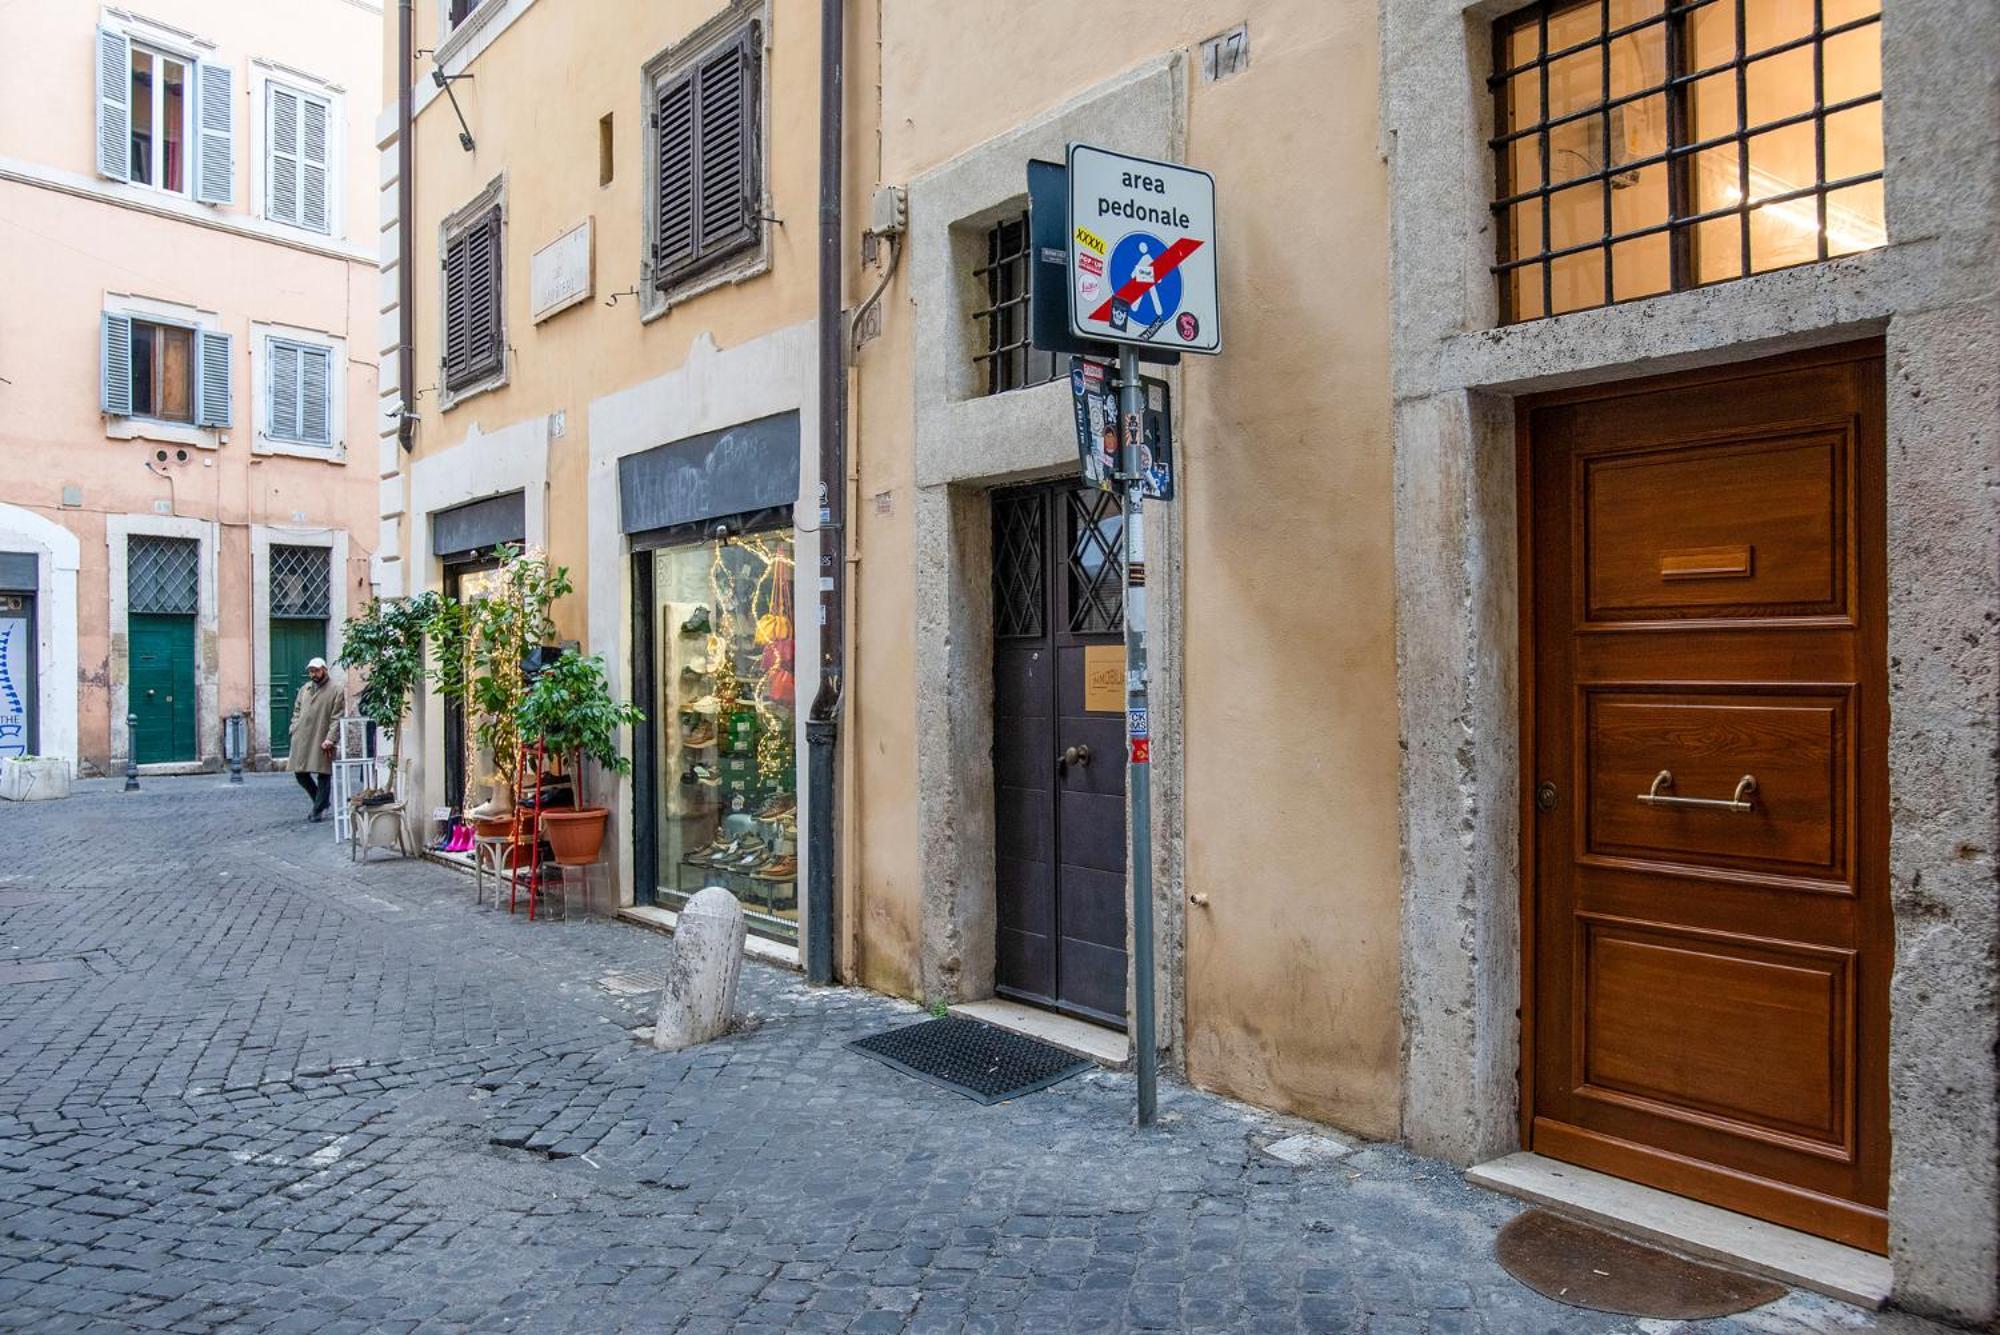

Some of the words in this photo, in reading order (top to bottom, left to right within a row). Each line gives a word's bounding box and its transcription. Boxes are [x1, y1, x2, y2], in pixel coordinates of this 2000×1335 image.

[1214, 33, 1242, 81] 17
[1122, 172, 1165, 194] area
[1098, 197, 1190, 229] pedonale
[0, 715, 20, 723] THE
